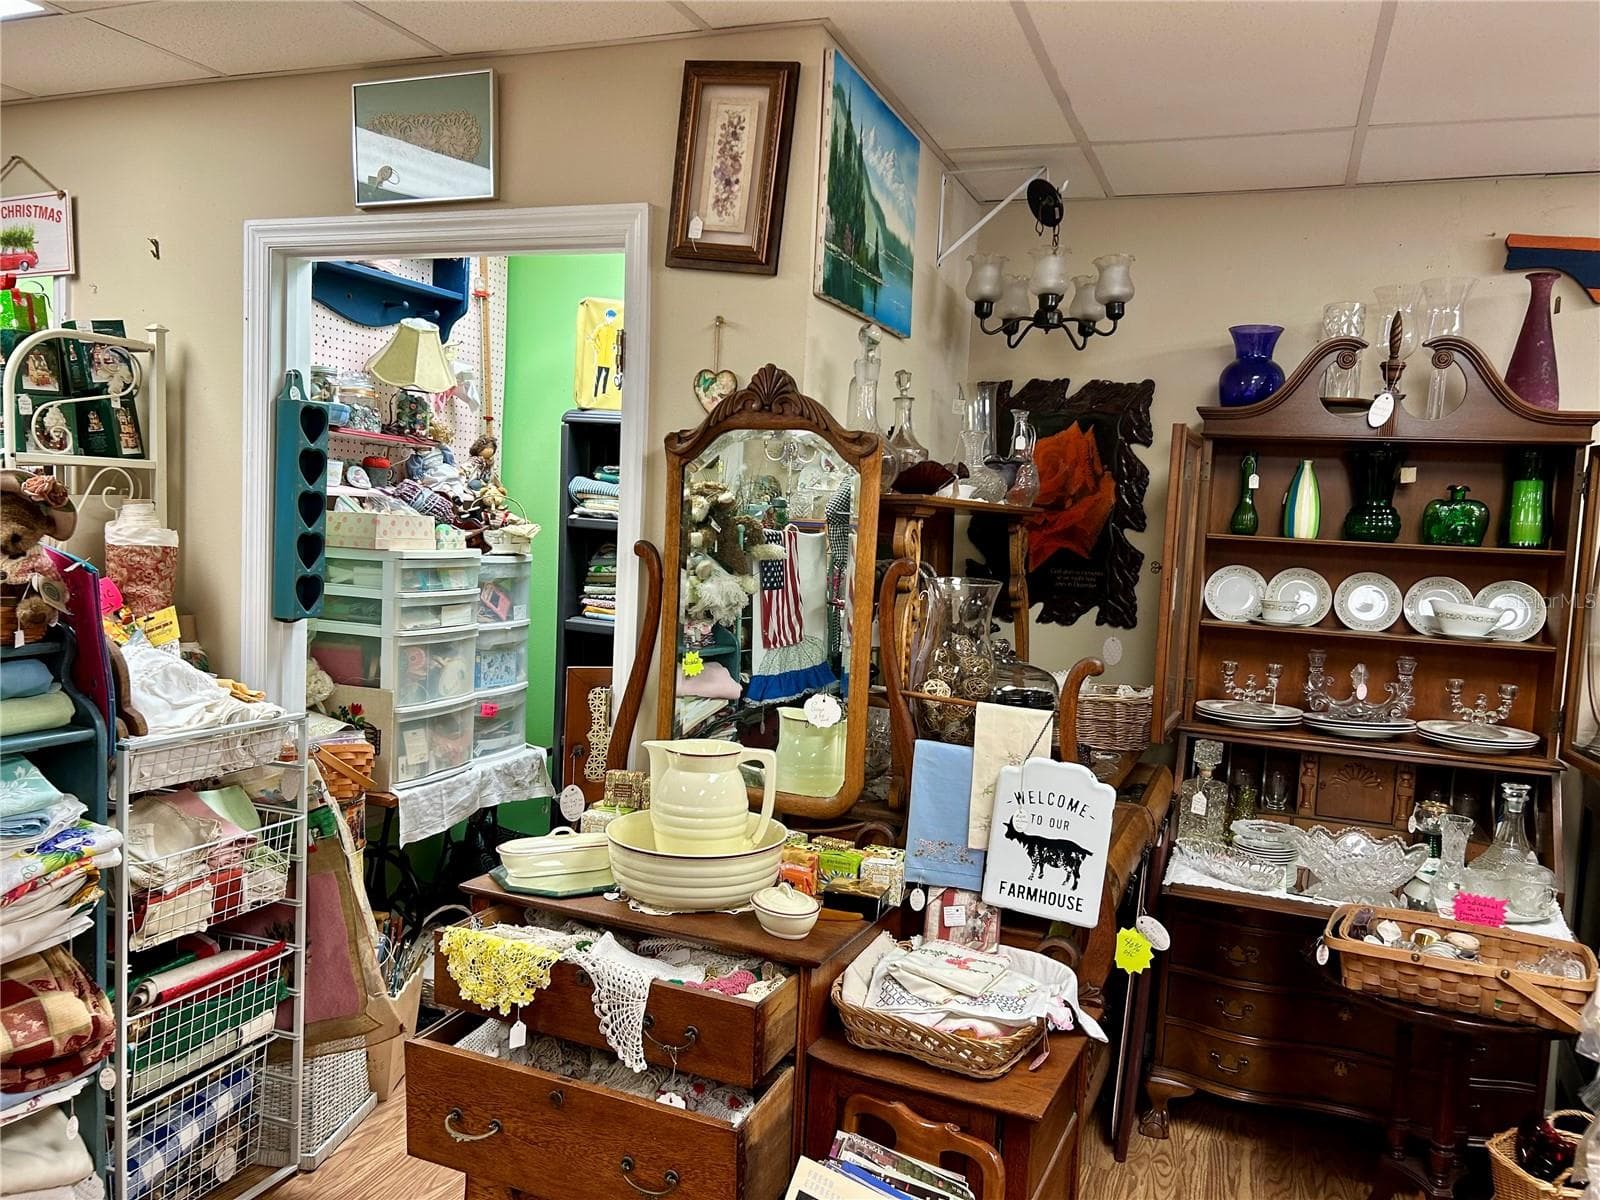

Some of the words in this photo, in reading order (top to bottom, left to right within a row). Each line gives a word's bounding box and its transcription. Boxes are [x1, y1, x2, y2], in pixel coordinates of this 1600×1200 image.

[1, 204, 62, 223] CHRISTMAS
[1013, 790, 1090, 818] WELCOME
[1031, 813, 1043, 826] TO
[1050, 817, 1070, 831] OUR
[999, 880, 1084, 913] FARMHOUSE
